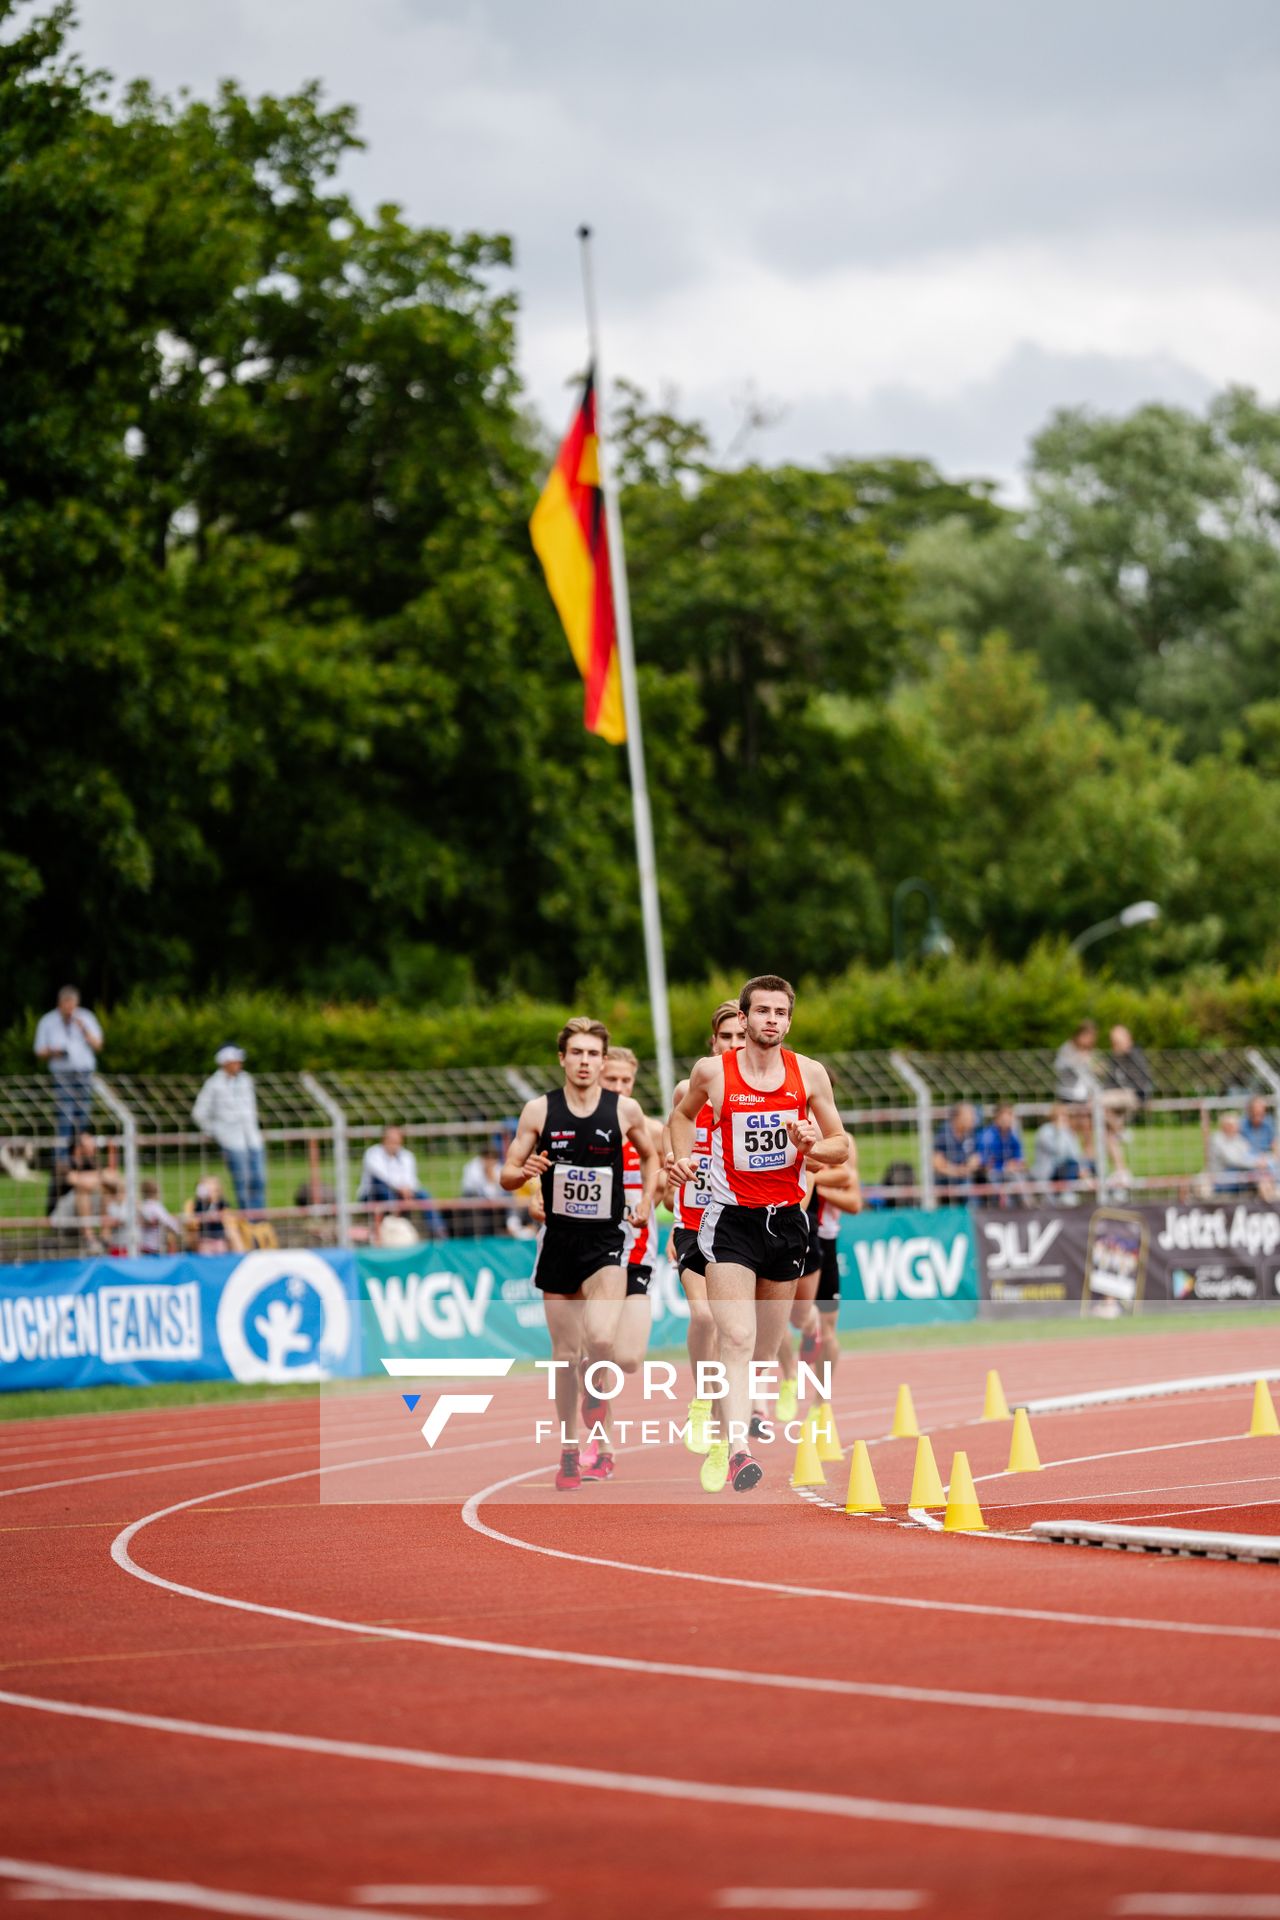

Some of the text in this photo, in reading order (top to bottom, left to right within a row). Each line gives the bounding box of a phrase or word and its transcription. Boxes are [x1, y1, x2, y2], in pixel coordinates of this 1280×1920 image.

[739, 1094, 766, 1103] Brillux
[744, 1128, 788, 1153] 530
[764, 1154, 785, 1163] PLAN
[563, 1182, 602, 1202] 503
[1158, 1206, 1228, 1250] Jetzt
[853, 1233, 969, 1303] WGV
[108, 1293, 195, 1350] FANS!
[365, 1267, 495, 1344] WGV
